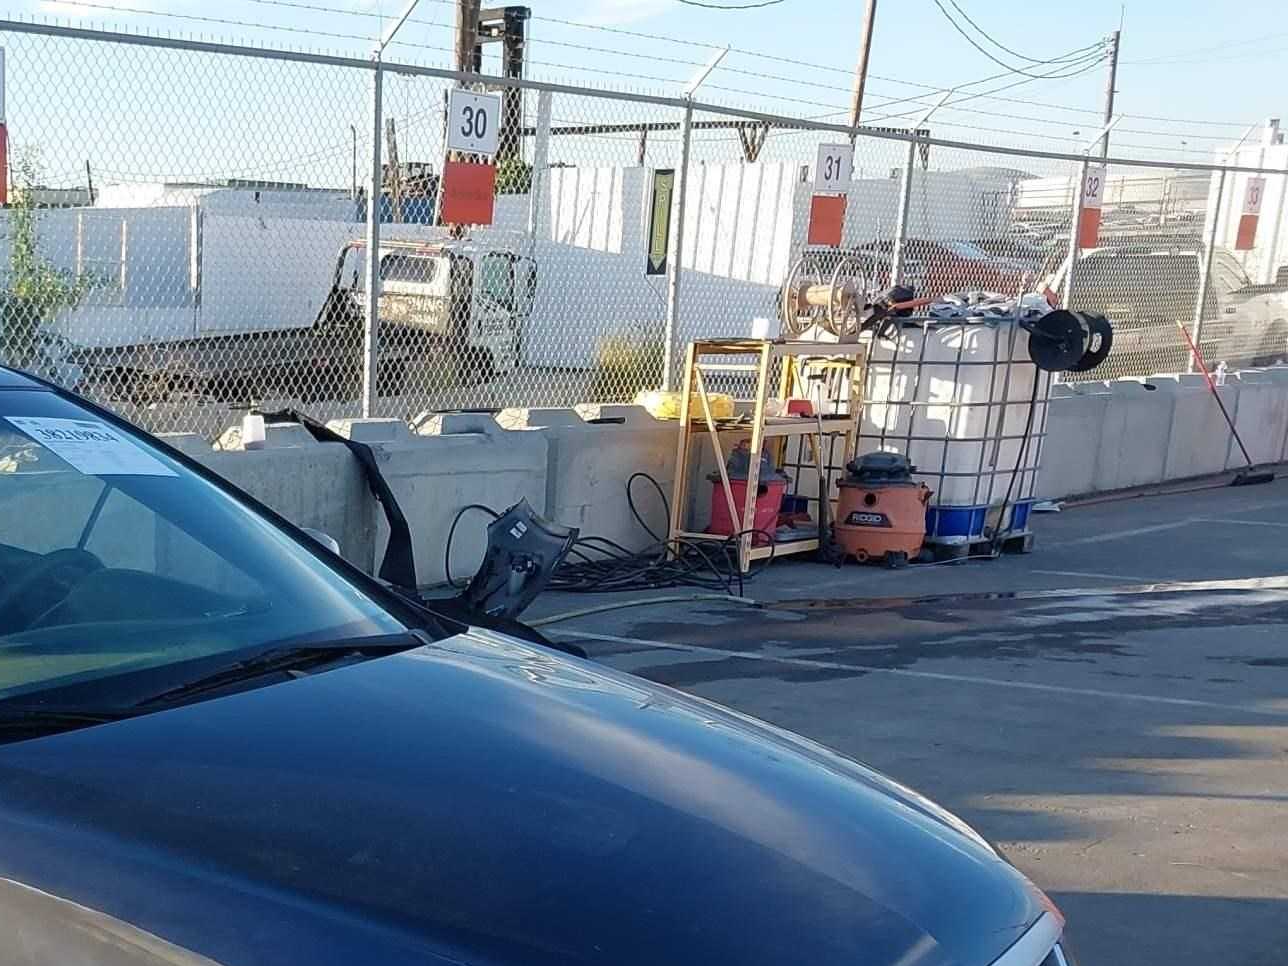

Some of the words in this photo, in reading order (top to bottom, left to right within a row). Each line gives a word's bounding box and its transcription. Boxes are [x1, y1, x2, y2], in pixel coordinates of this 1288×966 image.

[461, 106, 487, 139] 30
[825, 155, 841, 181] 31
[1085, 176, 1099, 198] 32
